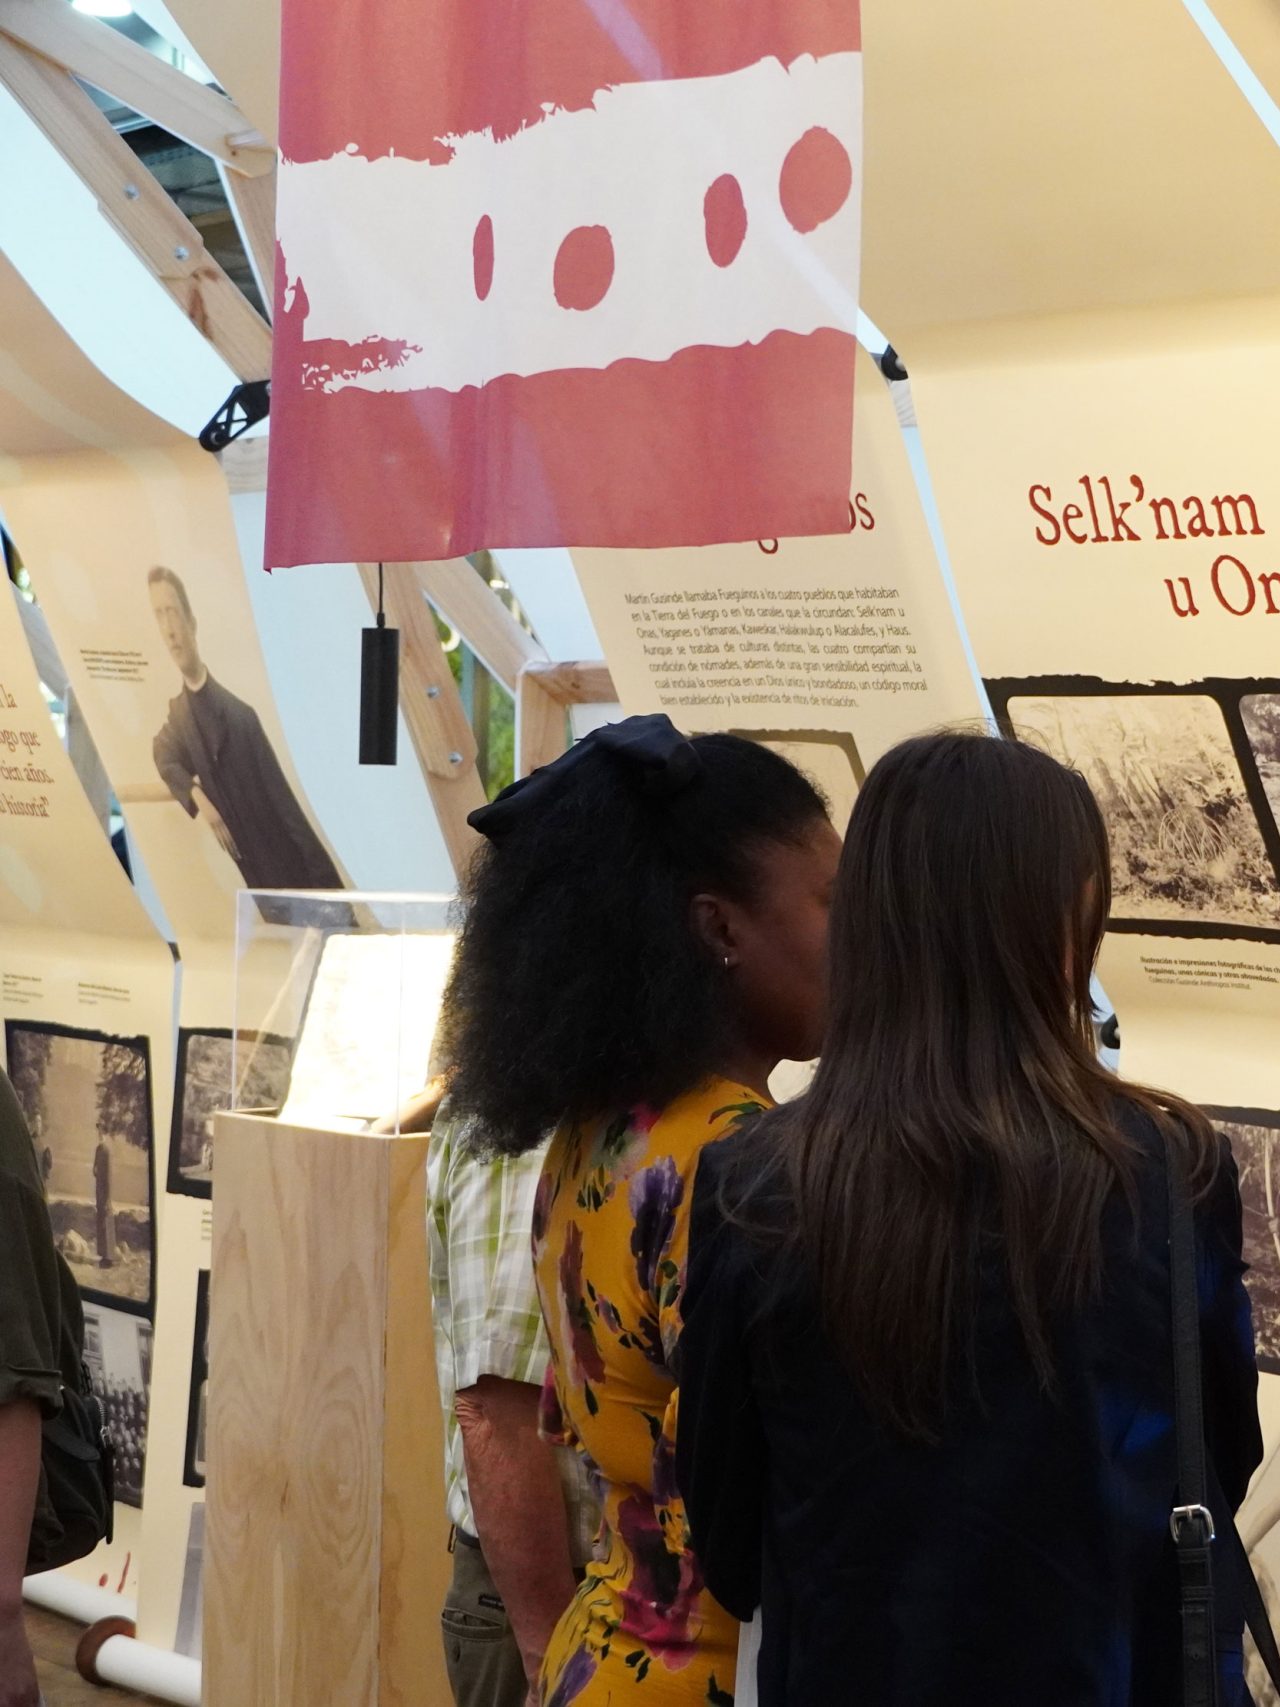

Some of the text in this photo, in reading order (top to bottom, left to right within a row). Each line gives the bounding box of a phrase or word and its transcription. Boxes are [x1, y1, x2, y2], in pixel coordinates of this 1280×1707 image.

[803, 586, 900, 602] pueblos que habitaban
[1164, 576, 1199, 618] u
[677, 608, 690, 620] del
[691, 608, 720, 622] Fuego
[722, 609, 728, 618] o
[898, 608, 906, 618] u
[826, 626, 832, 636] o
[880, 627, 885, 638] y
[823, 642, 917, 656] cuatro compartían su
[822, 660, 922, 674] sensibilidad espiritual, la
[858, 679, 928, 694] un código moral
